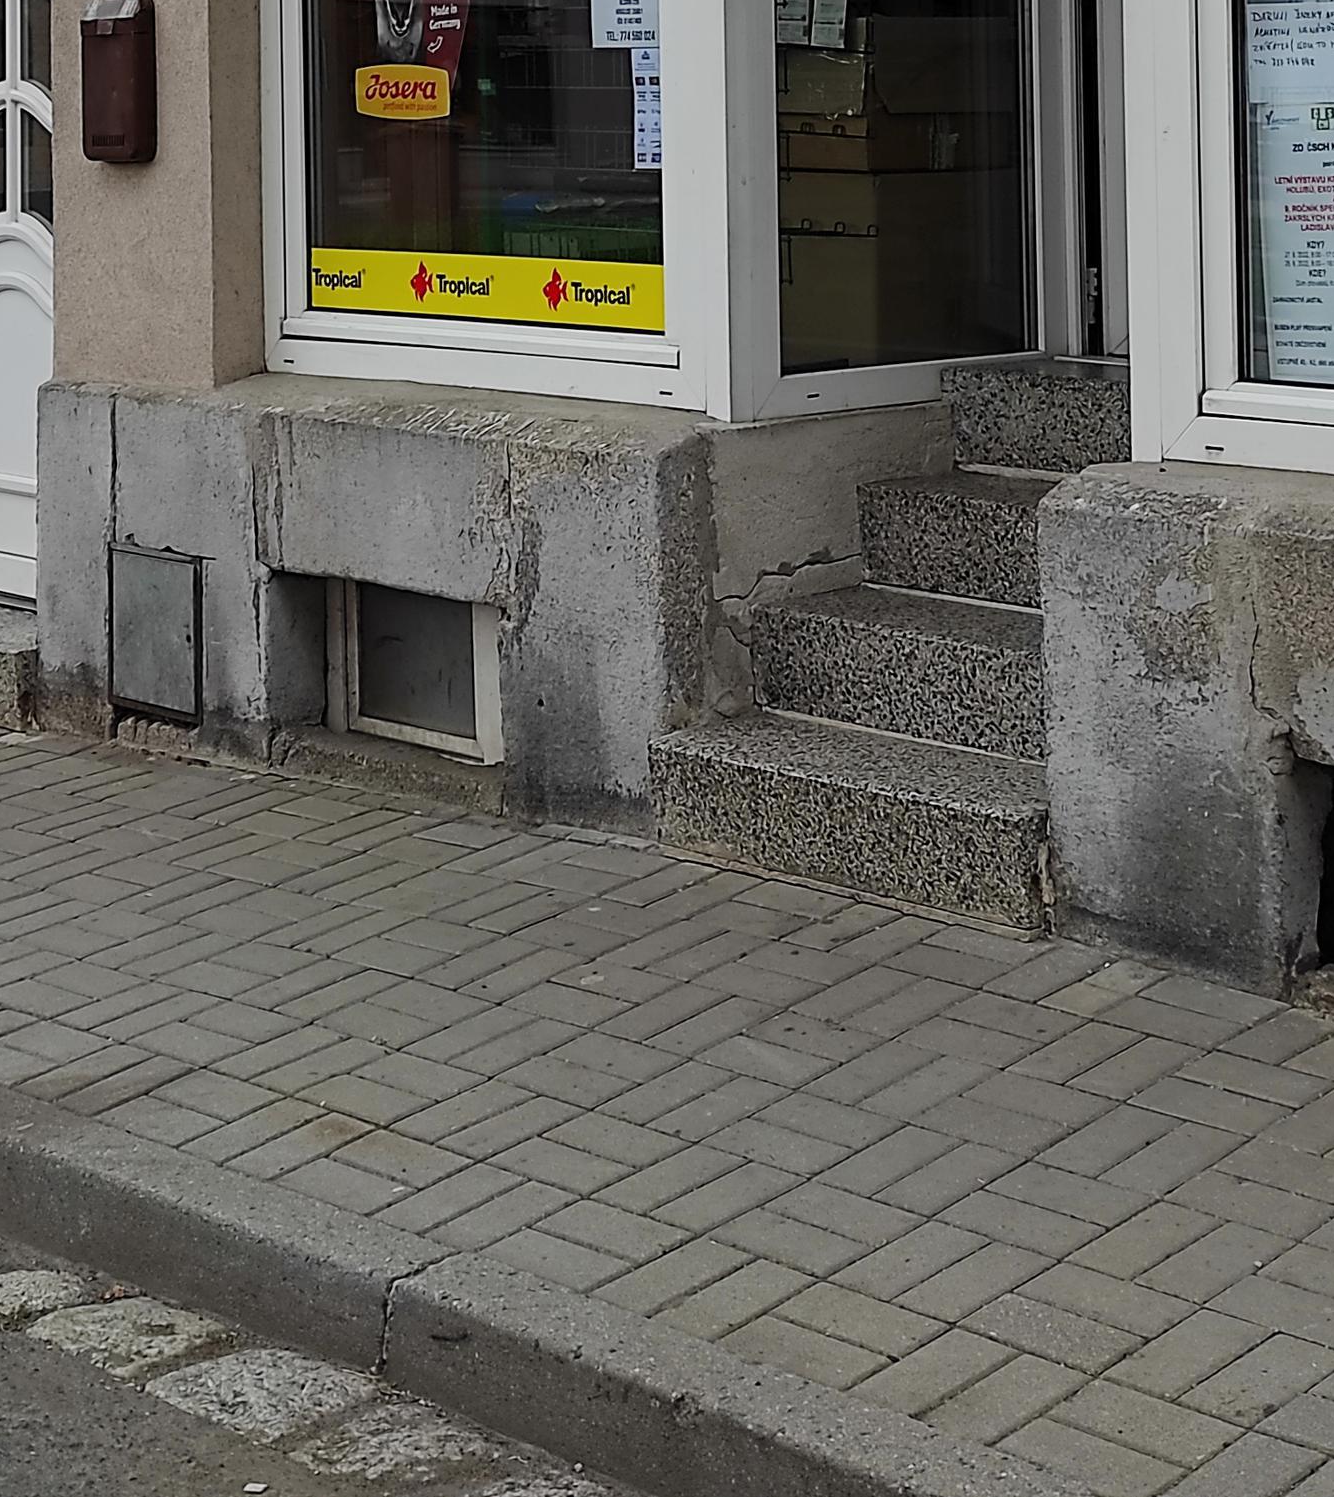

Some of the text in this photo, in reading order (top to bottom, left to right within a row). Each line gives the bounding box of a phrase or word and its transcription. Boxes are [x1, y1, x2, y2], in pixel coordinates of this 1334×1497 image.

[430, 4, 458, 17] Made in
[365, 74, 438, 101] Josera
[1307, 141, 1329, 152] ČSCH
[1295, 174, 1325, 184] VÝSTAVU
[312, 266, 362, 289] Tropical
[436, 273, 490, 298] Tropical
[571, 281, 631, 307] Tropical
